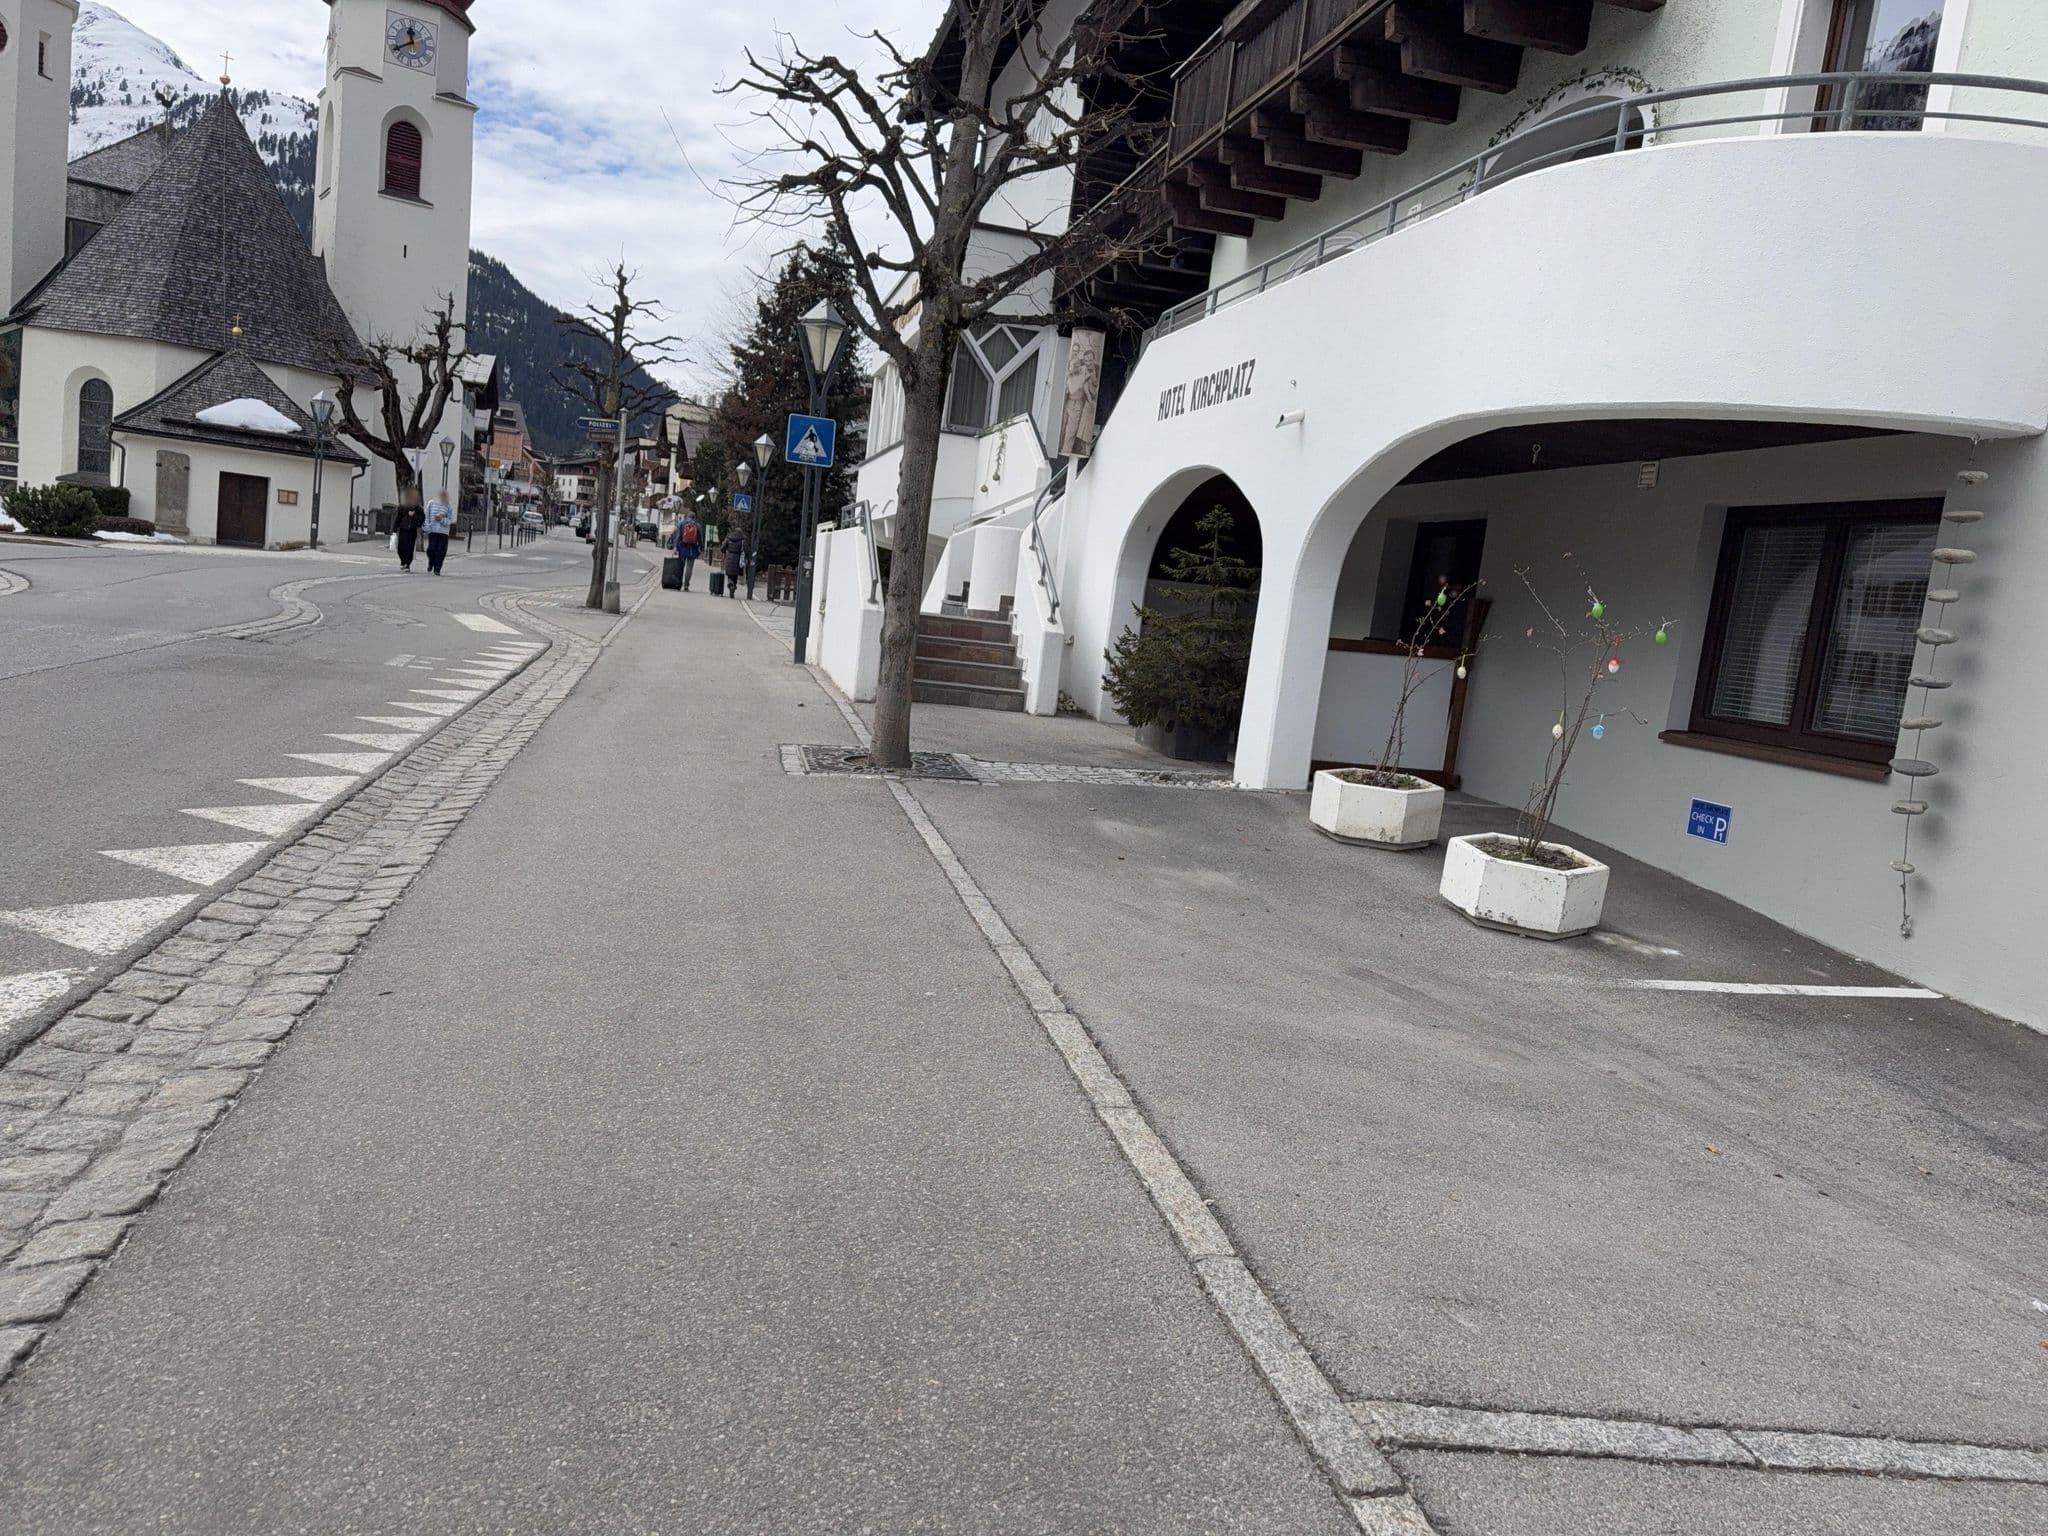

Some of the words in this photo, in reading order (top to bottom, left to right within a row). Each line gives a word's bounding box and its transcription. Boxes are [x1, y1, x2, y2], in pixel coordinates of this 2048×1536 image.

[1158, 383, 1187, 421] HOTEL
[1190, 359, 1256, 412] KIRCHPLATZ
[588, 420, 612, 429] POLIZEI
[1691, 811, 1715, 825] CHECK
[1697, 825, 1705, 835] IN
